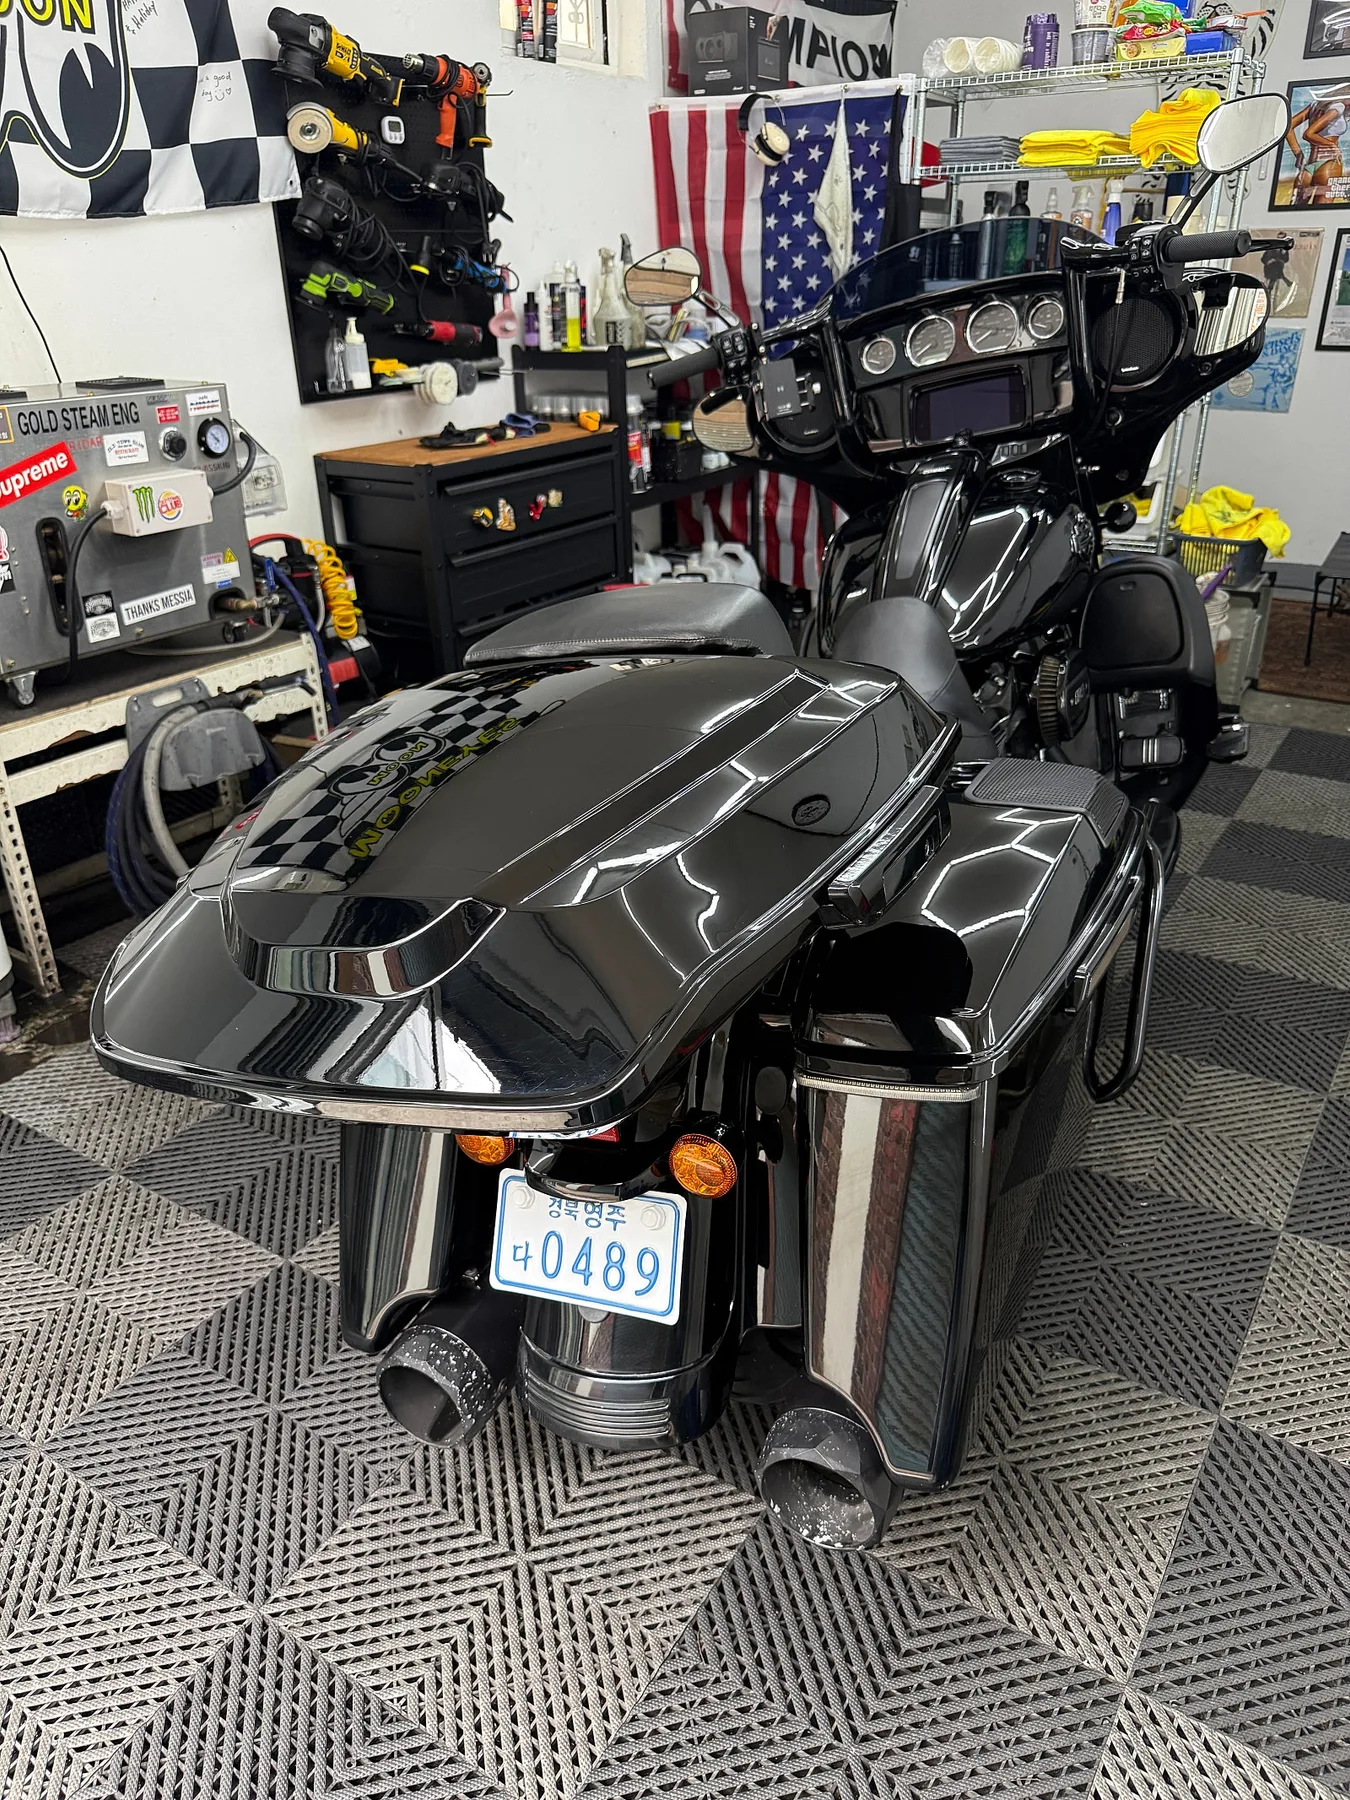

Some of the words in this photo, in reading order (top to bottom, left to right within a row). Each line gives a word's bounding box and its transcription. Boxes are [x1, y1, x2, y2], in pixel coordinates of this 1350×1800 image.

[214, 71, 232, 87] good
[17, 410, 59, 436] GOLD
[61, 404, 110, 431] STEAM
[111, 401, 140, 425] ENG
[0, 452, 69, 499] upreme
[158, 496, 183, 514] CLUB
[124, 600, 161, 621] THANKS
[160, 589, 194, 612] MESSIA
